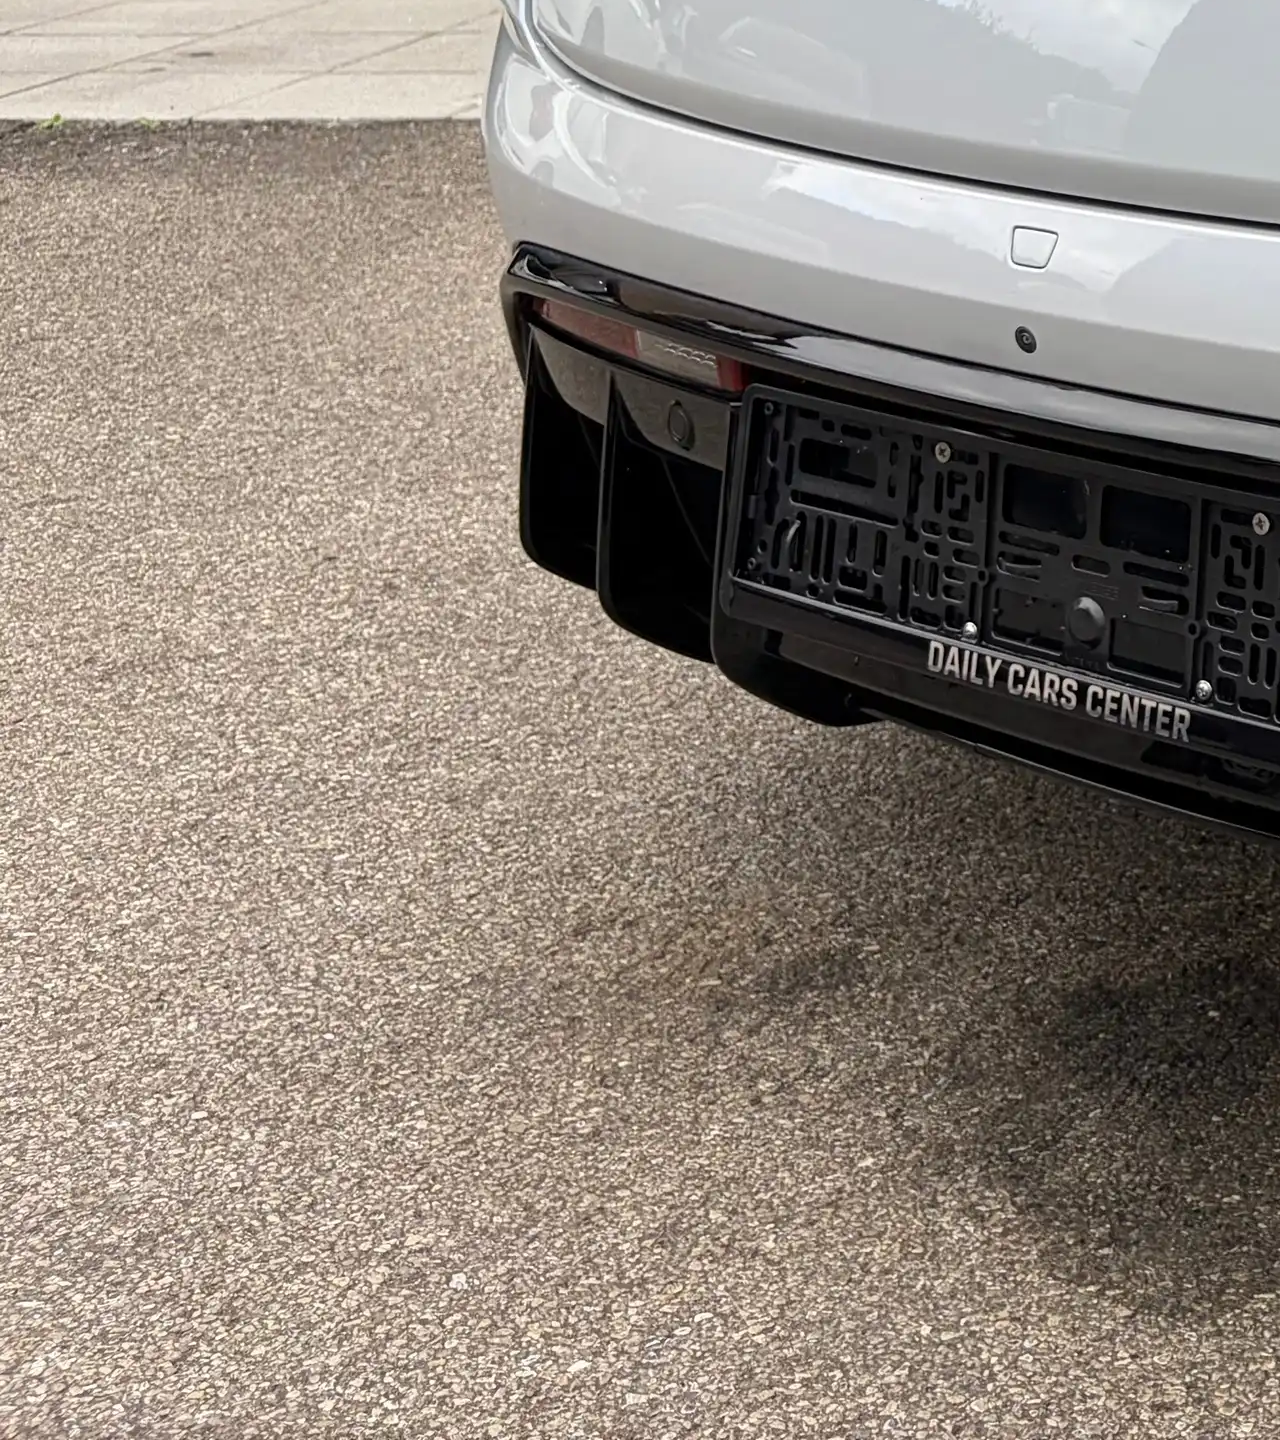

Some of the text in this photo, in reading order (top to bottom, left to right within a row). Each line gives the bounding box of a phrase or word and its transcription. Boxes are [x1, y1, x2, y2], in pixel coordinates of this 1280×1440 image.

[926, 640, 1191, 743] DAILY CARS CENTER
